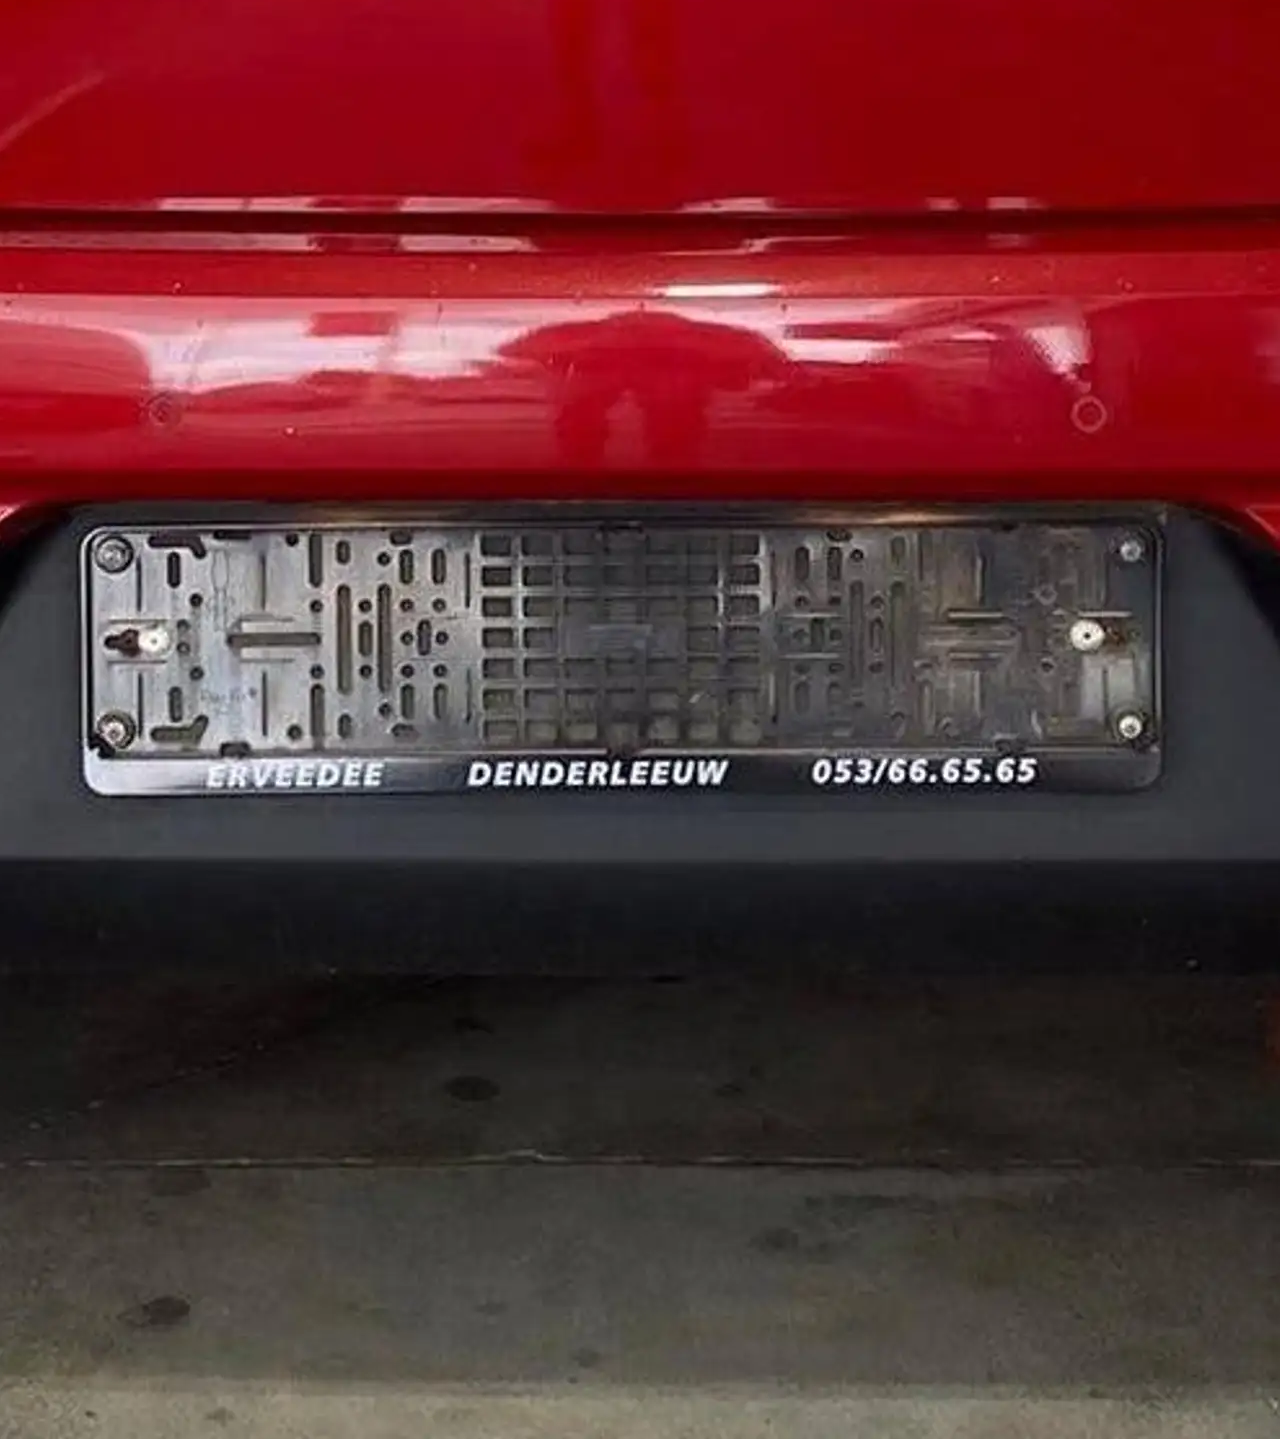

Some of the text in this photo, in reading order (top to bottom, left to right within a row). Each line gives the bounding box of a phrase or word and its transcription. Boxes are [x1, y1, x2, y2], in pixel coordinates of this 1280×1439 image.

[206, 757, 1038, 788] ERVEEDEE DENDERLEEUW 053/66.65.65
